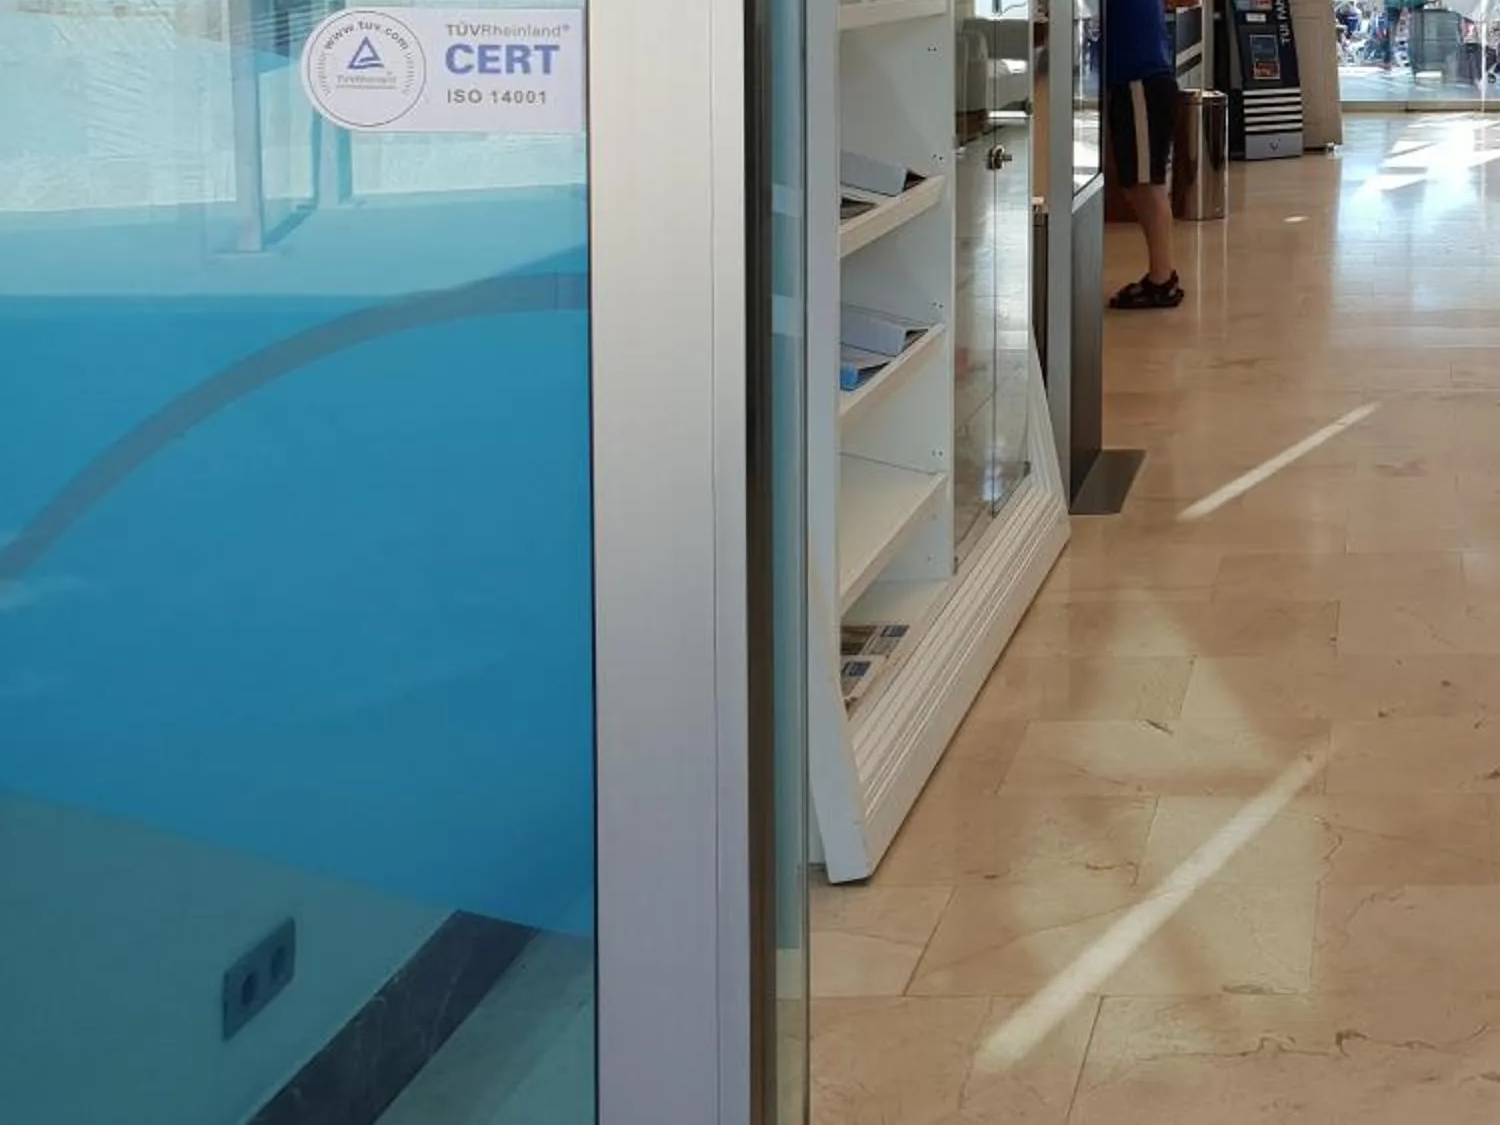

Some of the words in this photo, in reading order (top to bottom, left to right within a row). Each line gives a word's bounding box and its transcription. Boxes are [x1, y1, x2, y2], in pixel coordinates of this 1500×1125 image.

[446, 44, 560, 75] CERT
[447, 89, 482, 104] ISO
[490, 89, 547, 104] 14001
